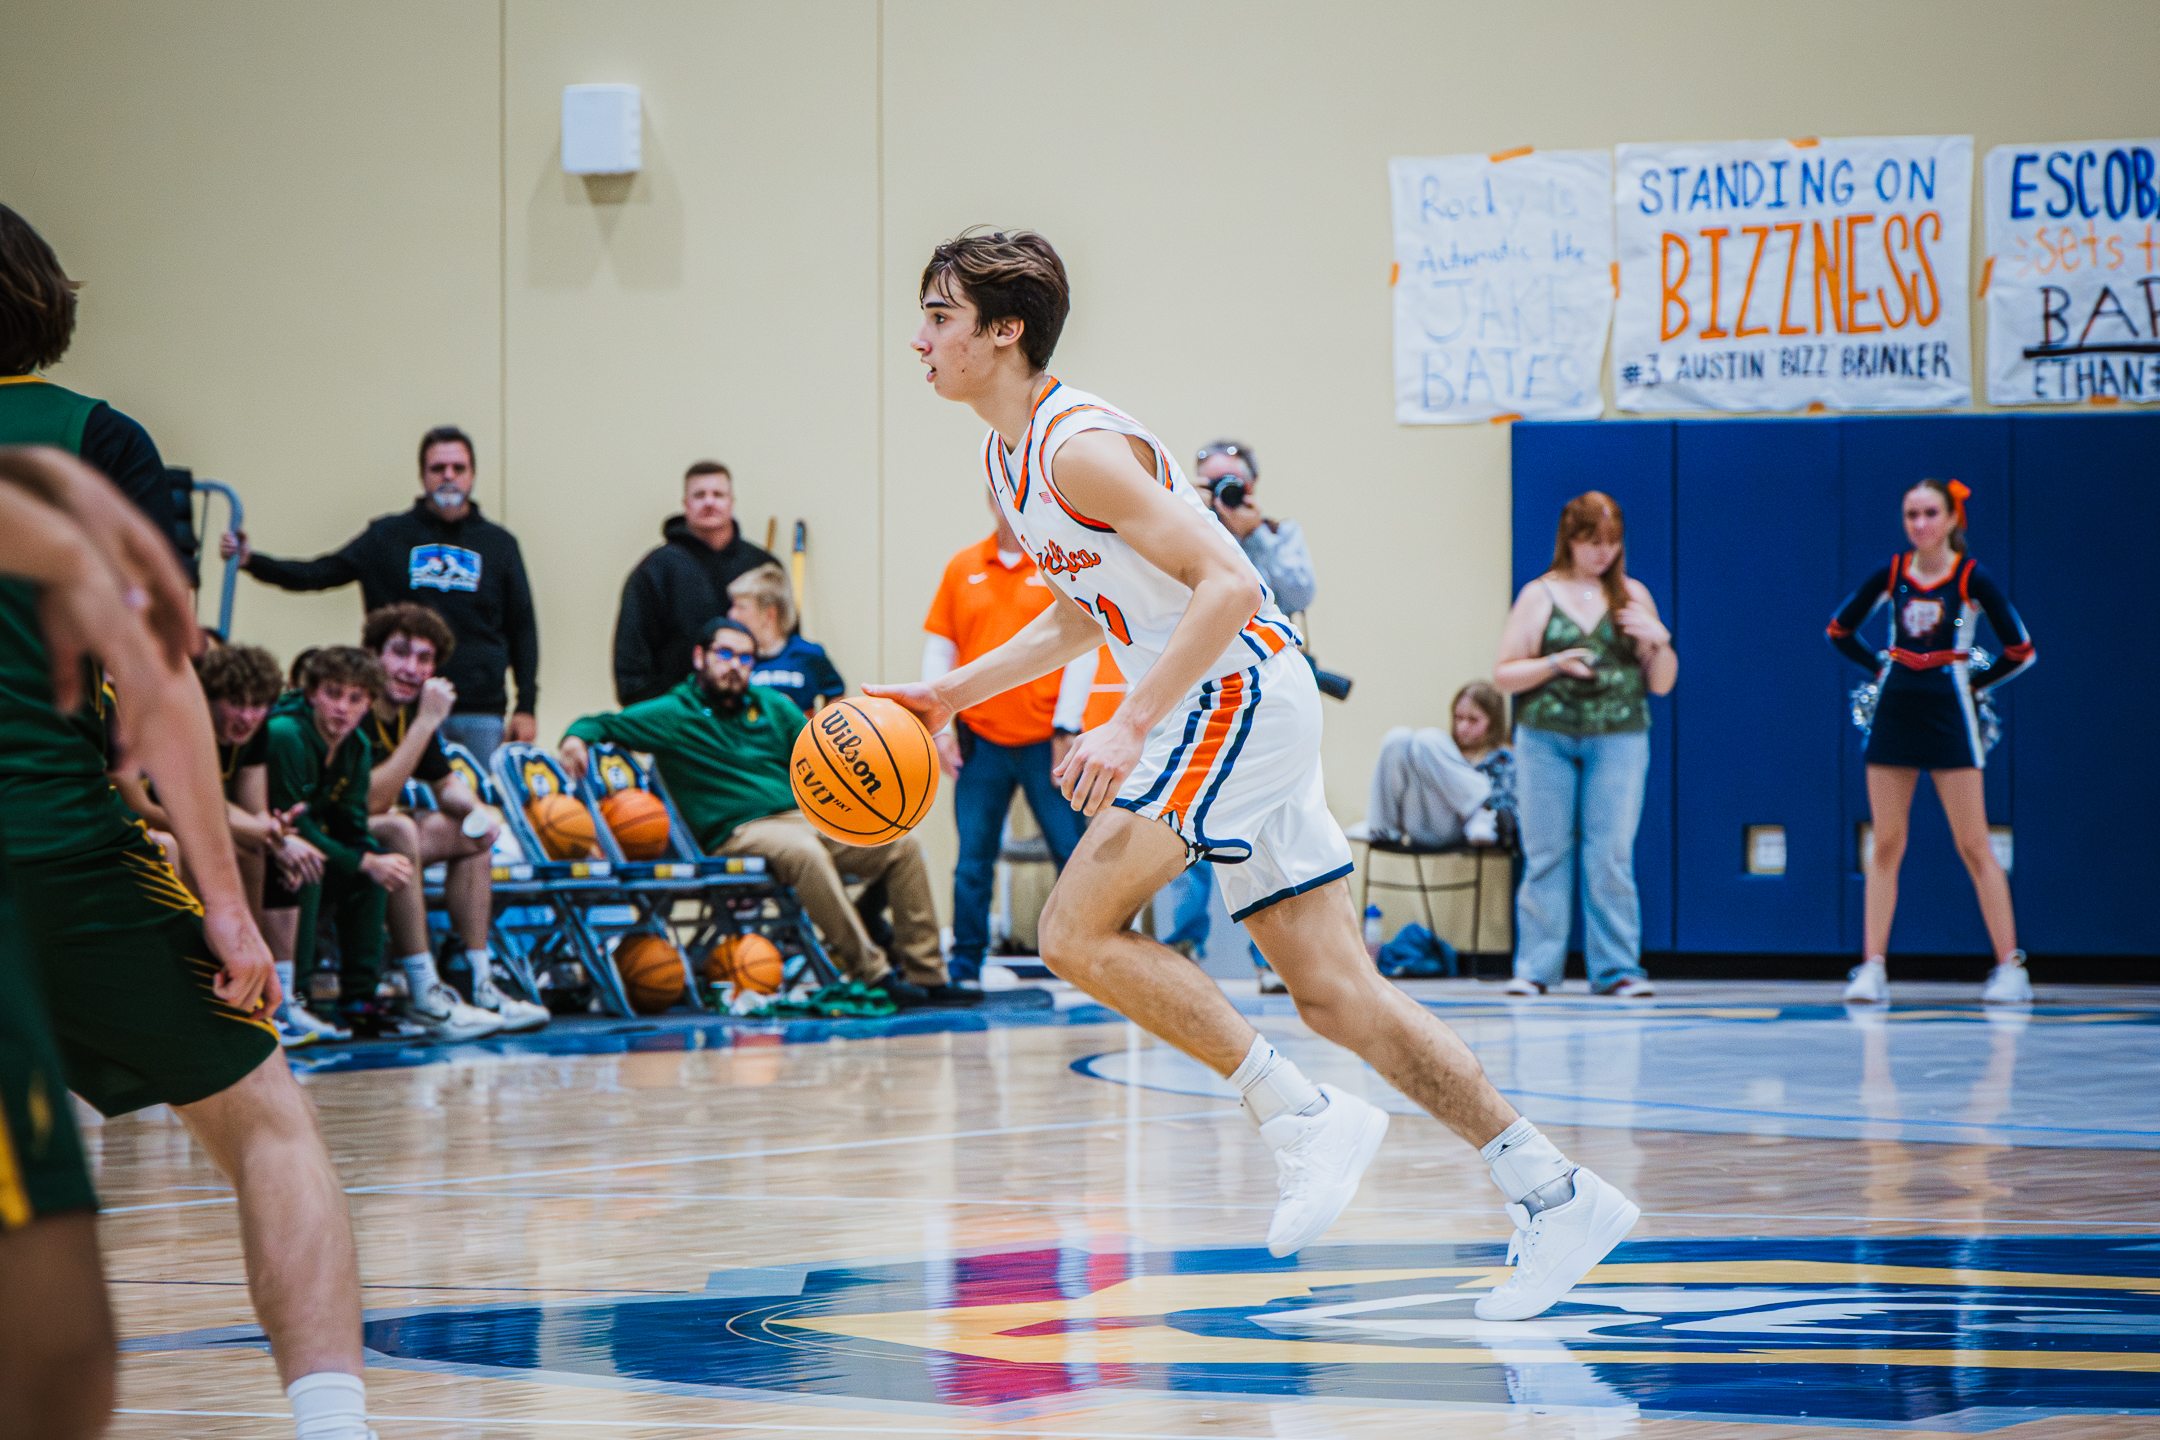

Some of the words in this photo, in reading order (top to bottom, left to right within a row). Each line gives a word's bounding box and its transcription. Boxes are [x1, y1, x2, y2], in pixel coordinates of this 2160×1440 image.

[1640, 158, 1855, 215] STANDING
[1876, 157, 1936, 202] ON
[2010, 147, 2160, 220] ESCOB
[1661, 212, 1942, 342] BIZZNESS
[2034, 219, 2124, 275] sets
[1422, 275, 1576, 346] JAKE
[1420, 347, 1584, 412] BATES
[1677, 351, 1764, 380] AUSTIN
[1842, 341, 1951, 379] BRINKER
[2034, 358, 2144, 397] ETHAN
[796, 757, 835, 805] EVO
[821, 709, 882, 797] Wilson
